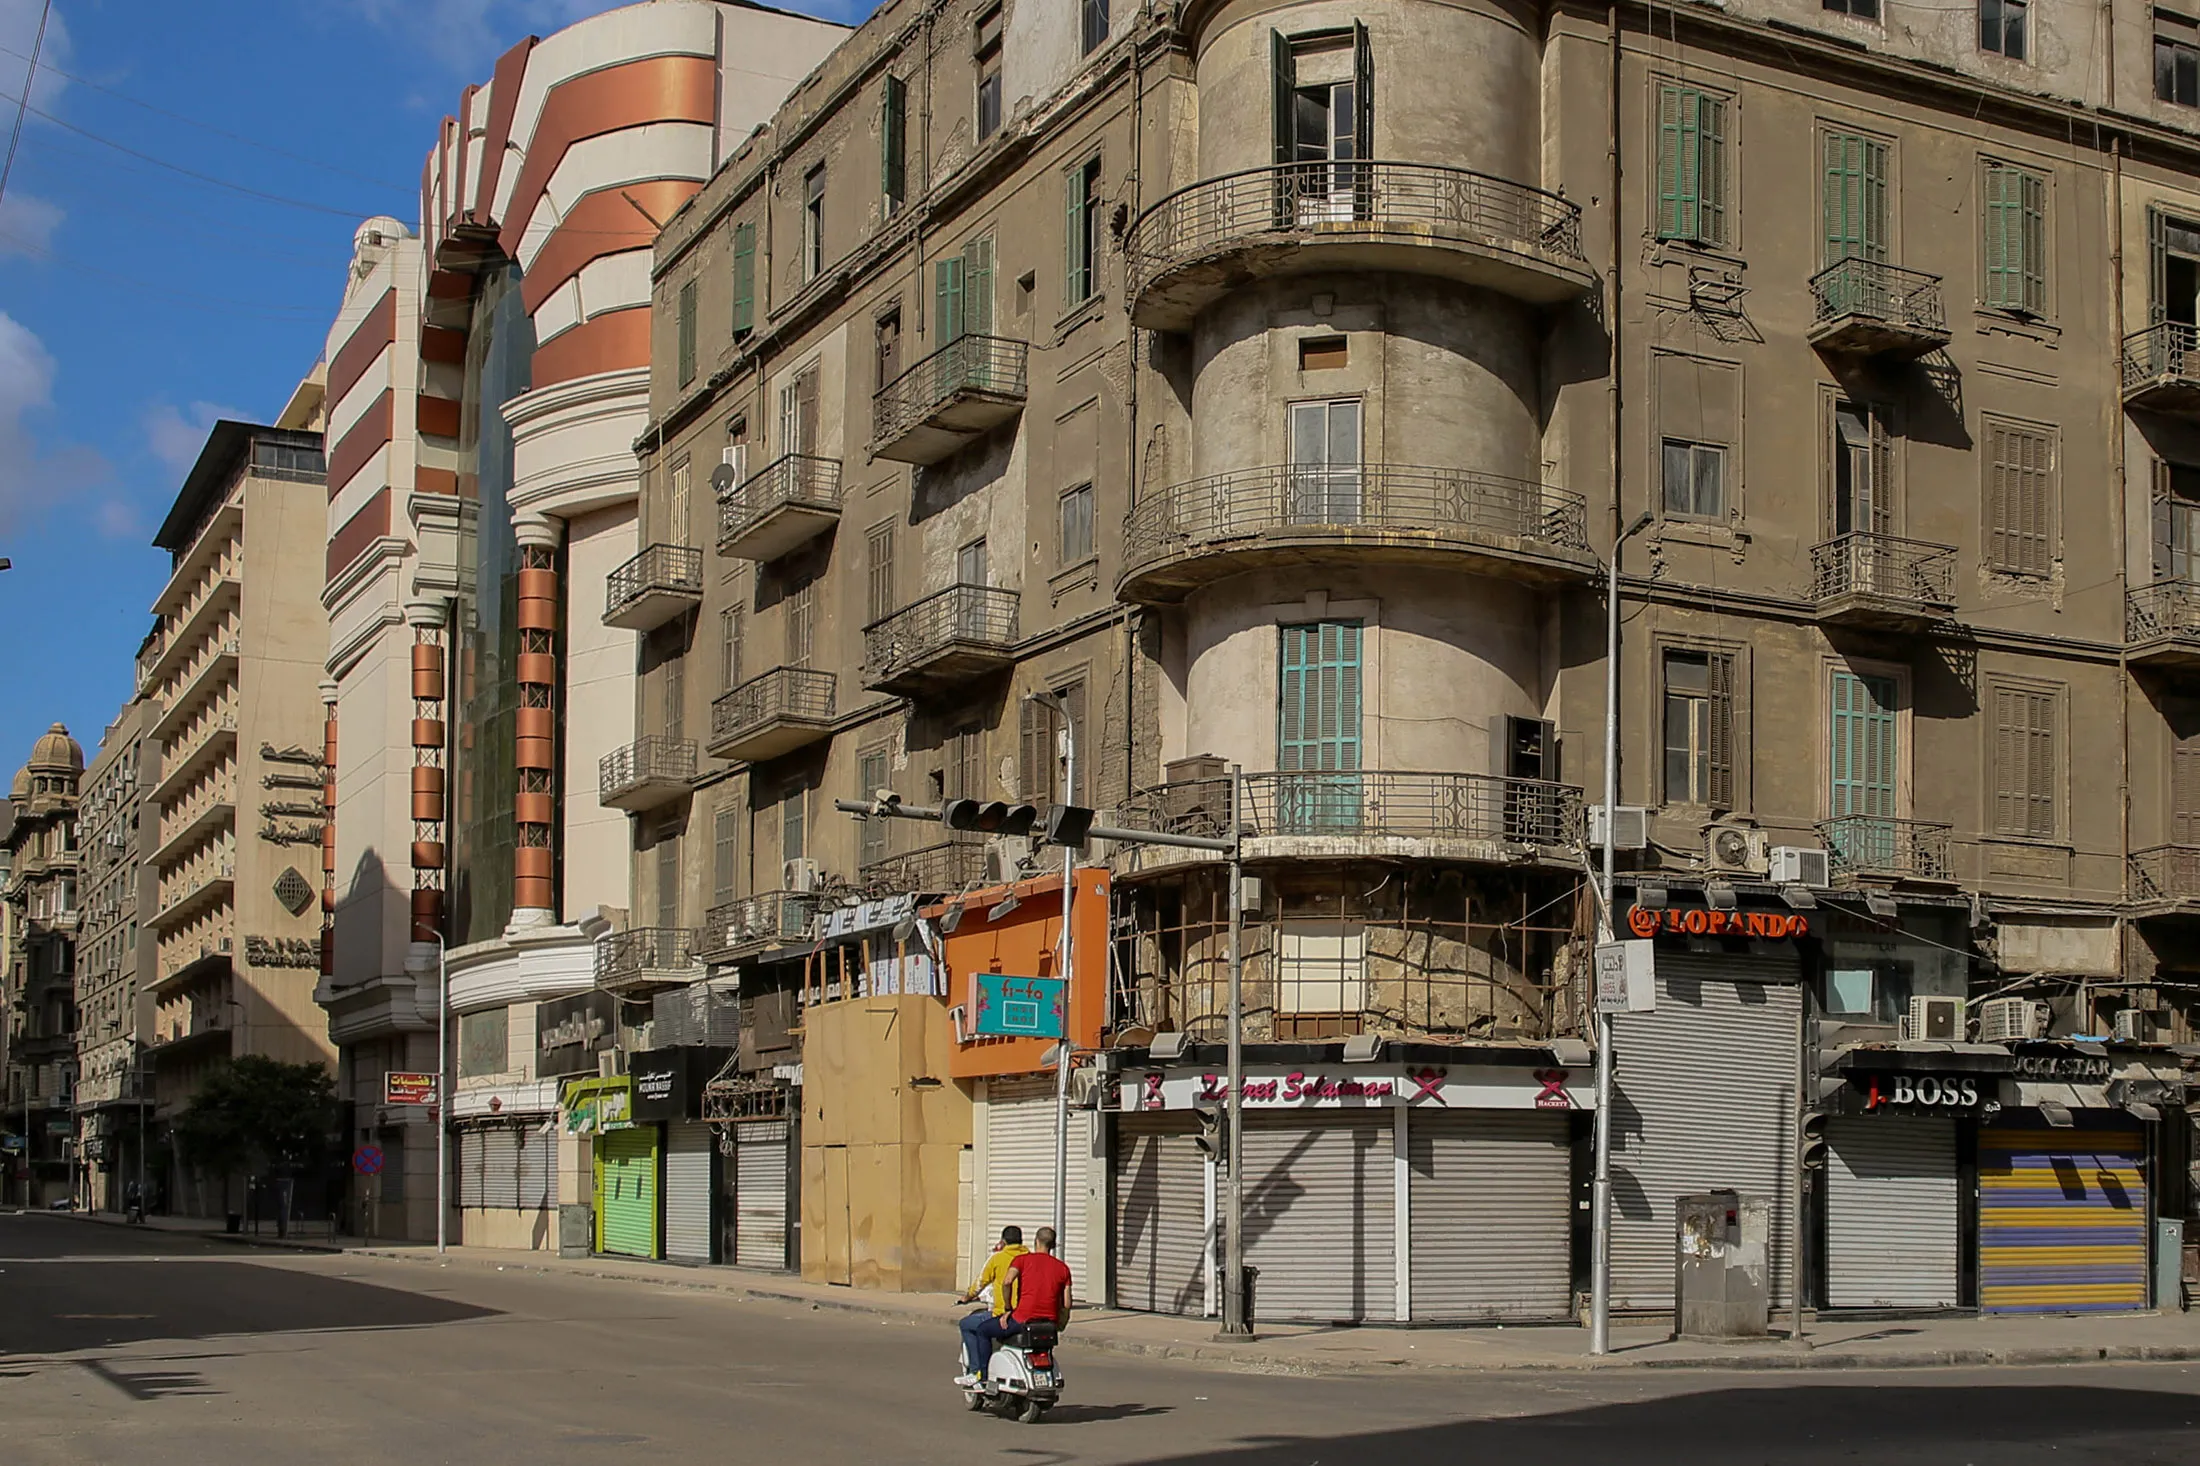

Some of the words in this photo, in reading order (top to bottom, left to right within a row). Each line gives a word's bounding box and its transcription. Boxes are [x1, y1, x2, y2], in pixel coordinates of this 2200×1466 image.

[1667, 909, 1808, 937] LOPANDO
[1001, 978, 1043, 1000] fi-fa
[2013, 1056, 2058, 1075] UCKY
[2061, 1058, 2110, 1076] STAR
[1890, 1075, 1978, 1106] BOSS
